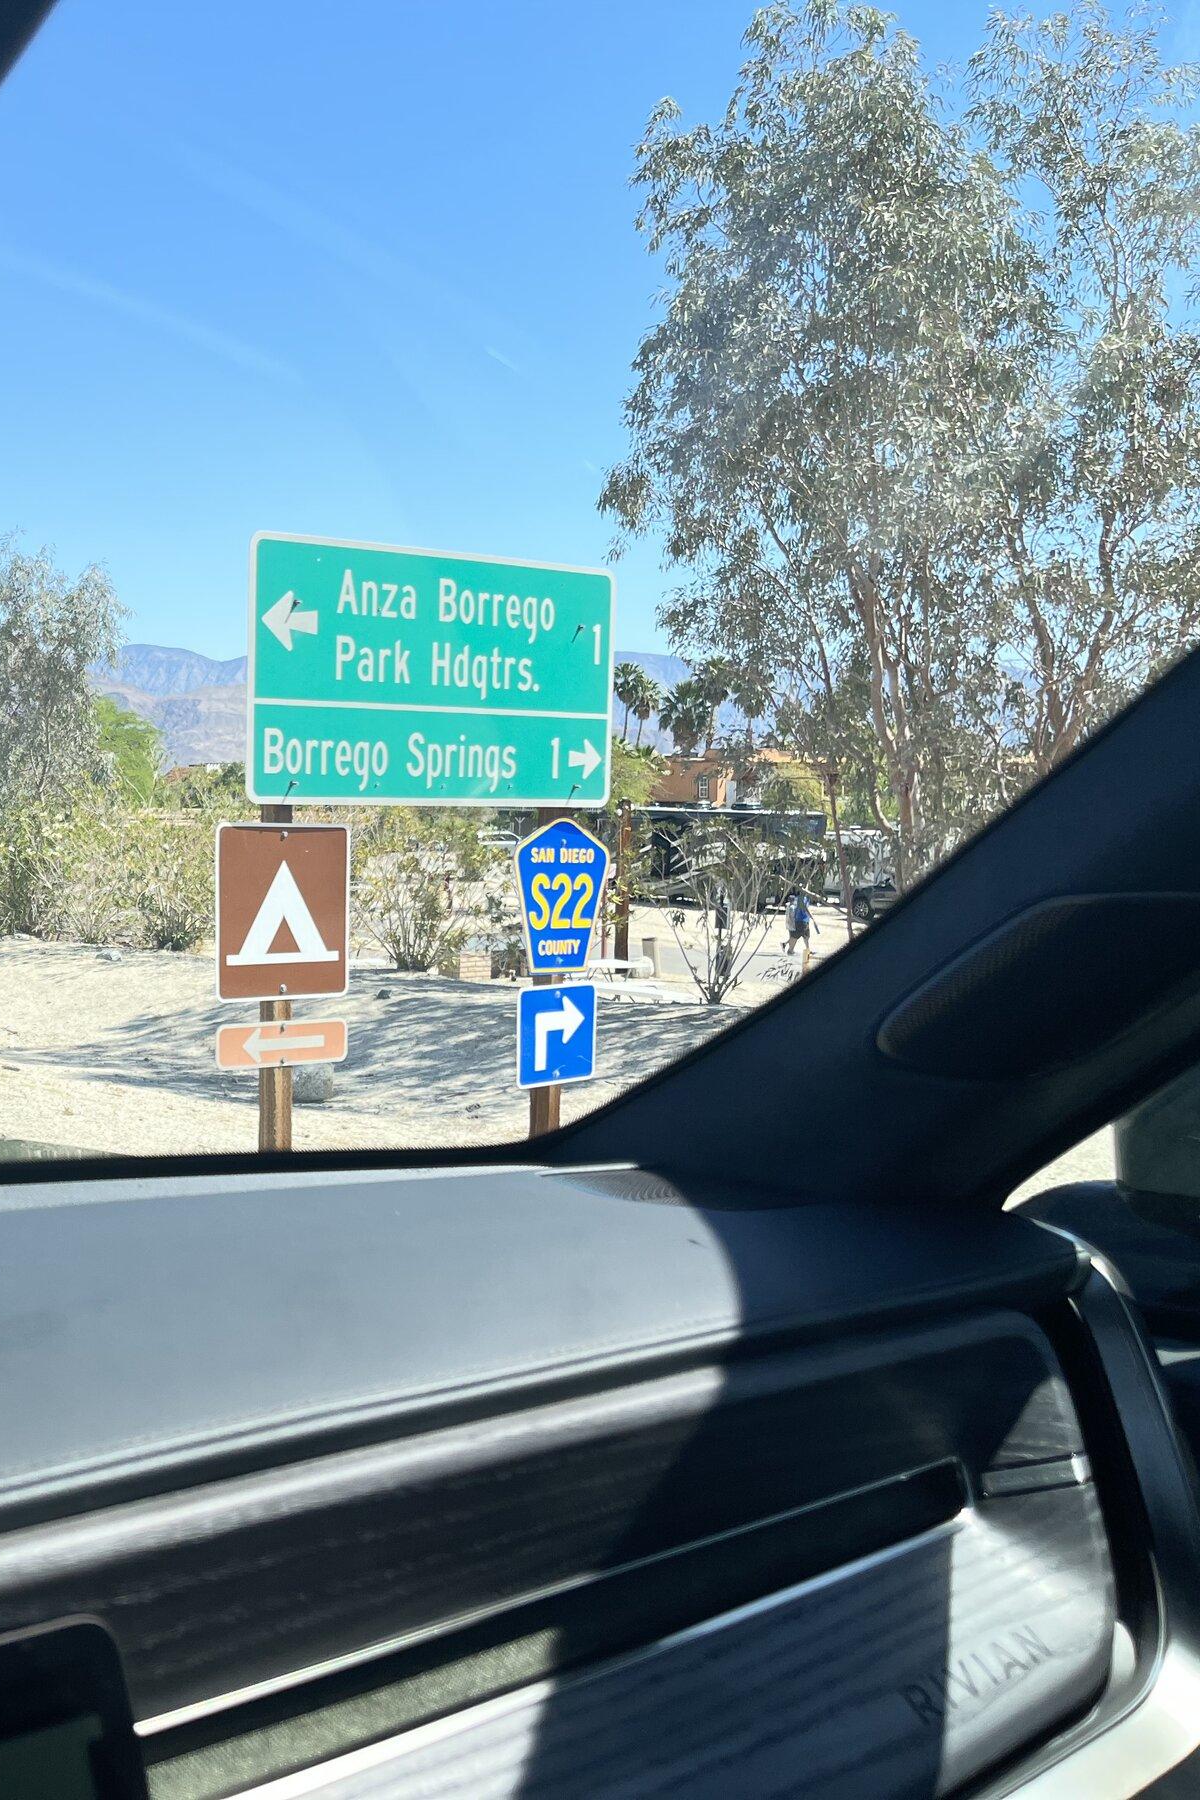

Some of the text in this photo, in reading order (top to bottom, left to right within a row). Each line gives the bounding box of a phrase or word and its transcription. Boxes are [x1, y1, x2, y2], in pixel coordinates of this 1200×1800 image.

[336, 568, 556, 644] Anza Borrego
[335, 634, 541, 700] Park Hdqtrs.
[591, 623, 602, 666] 1
[262, 727, 560, 793] Borrego Springs 1
[530, 847, 595, 864] SAN DIEGO
[528, 872, 594, 931] S22
[537, 938, 582, 957] COUNTY
[904, 1624, 1054, 1726] RIVIAN
